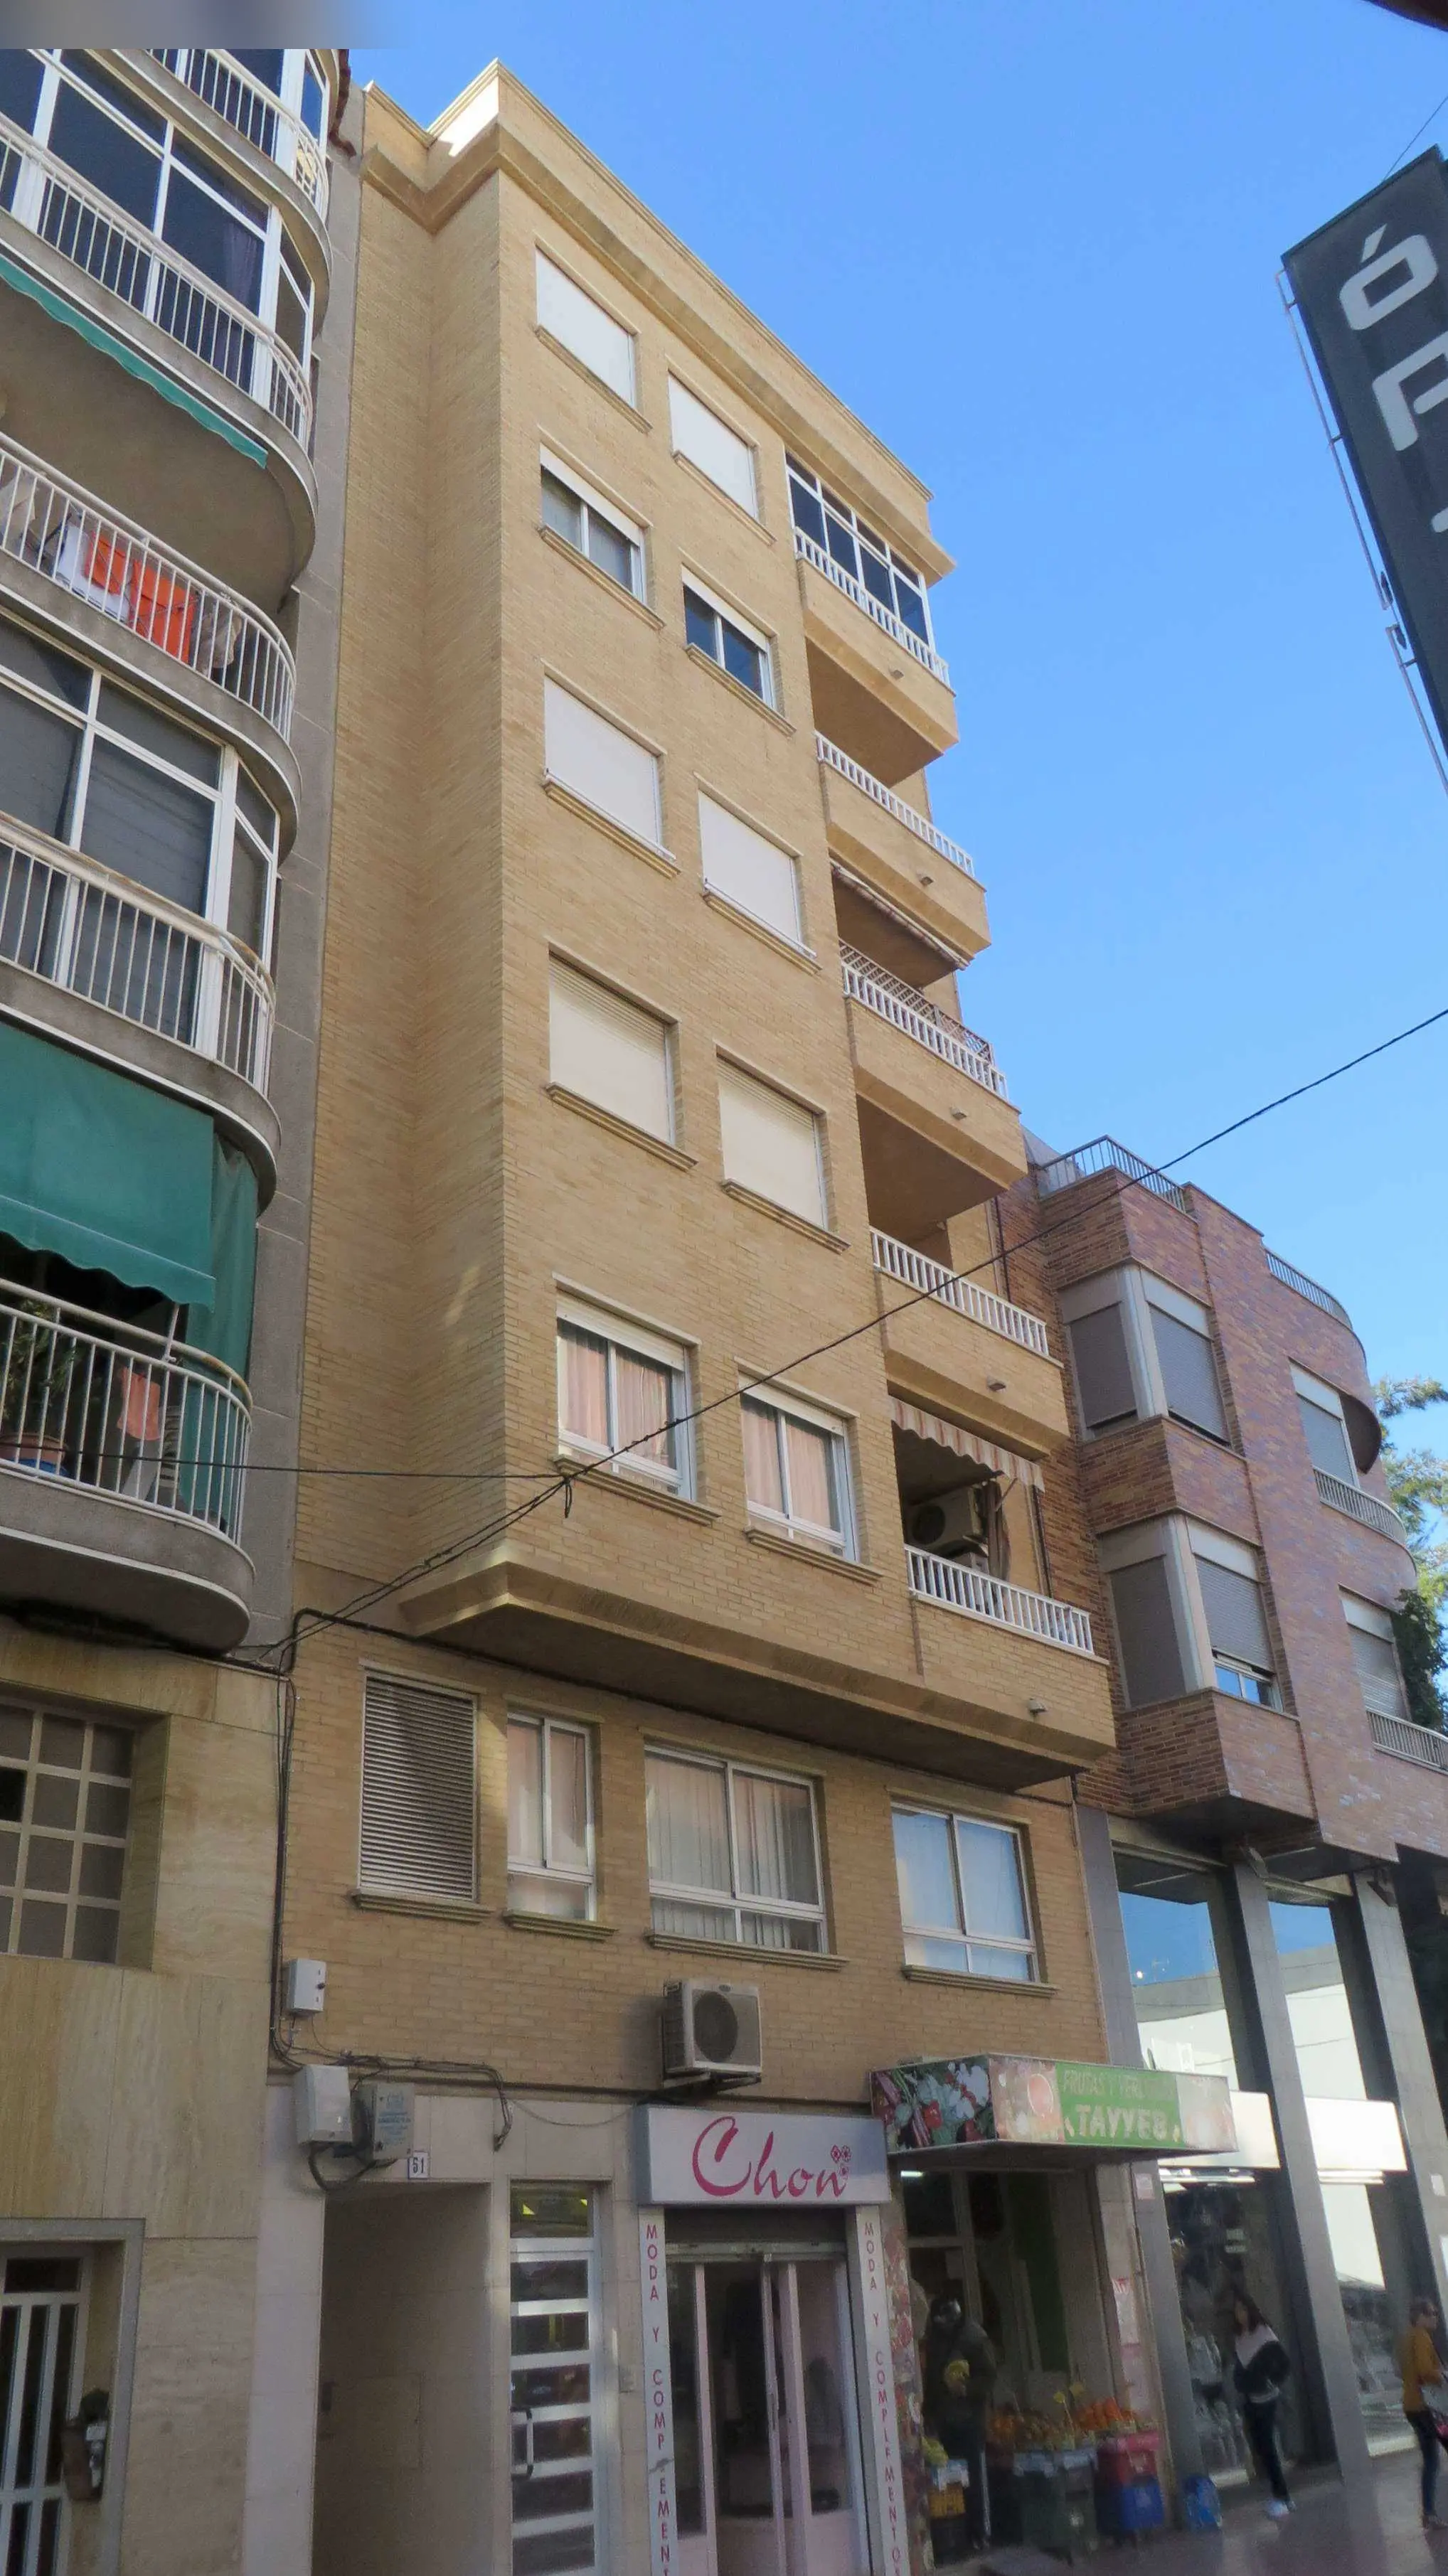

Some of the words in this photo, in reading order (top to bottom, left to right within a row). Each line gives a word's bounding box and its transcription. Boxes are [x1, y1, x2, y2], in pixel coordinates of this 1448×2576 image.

[1339, 223, 1448, 533] ÓP
[692, 2116, 846, 2198] Chon
[646, 2224, 659, 2301] MODA
[864, 2223, 877, 2291] MODA
[873, 2312, 879, 2328] Y
[652, 2326, 659, 2343] Y
[653, 2368, 670, 2576] COMPEMENT
